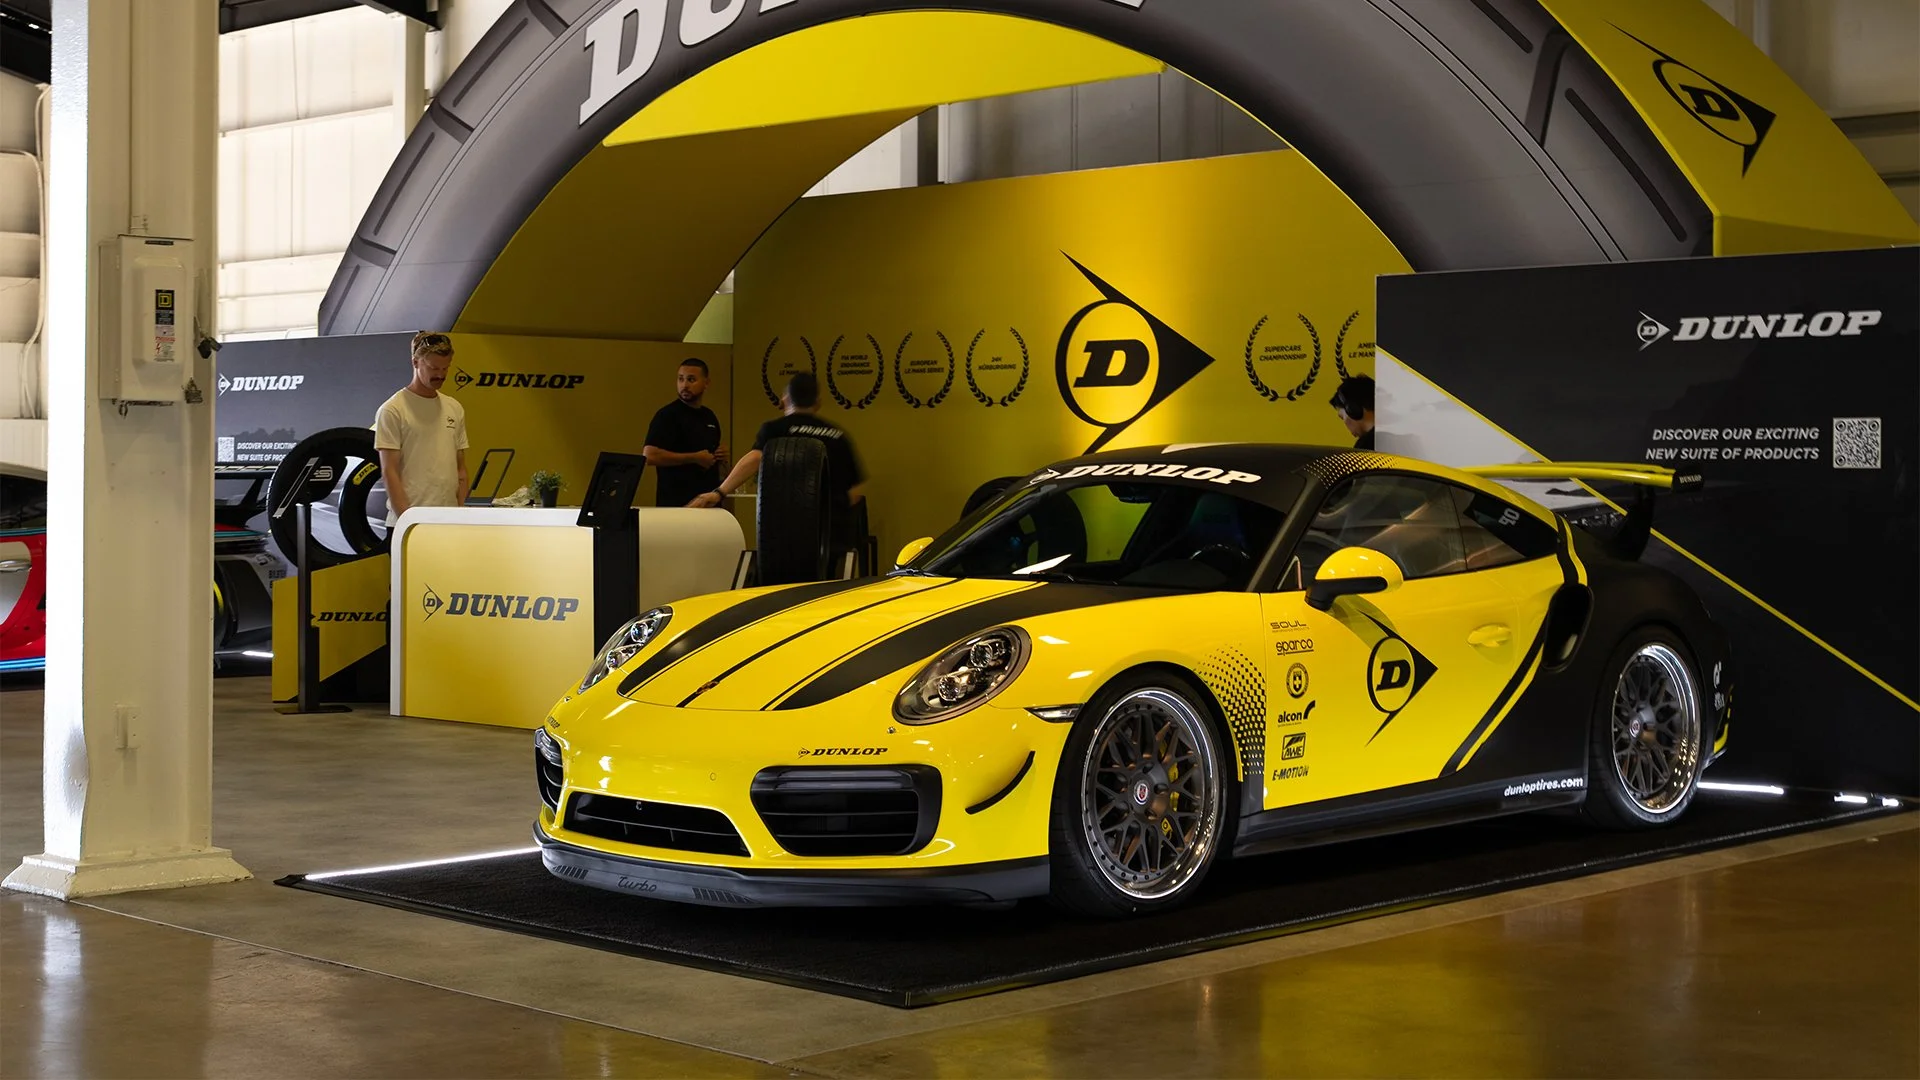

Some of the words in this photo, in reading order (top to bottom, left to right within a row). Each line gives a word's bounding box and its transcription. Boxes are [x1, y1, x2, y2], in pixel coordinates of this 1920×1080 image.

[1678, 83, 1740, 121] D
[1672, 310, 1882, 341] DUNLOP
[1073, 339, 1150, 388] D
[1260, 353, 1307, 361] CHAMPIONSHIP
[231, 375, 304, 391] DUNLOP
[475, 372, 584, 389] DUNLOP
[1653, 428, 1719, 440] DISCOVER
[1722, 428, 1752, 440] OUR
[1755, 427, 1820, 440] EXCITING
[237, 442, 262, 450] DISCOVER
[262, 442, 273, 450] OUR
[1645, 448, 1678, 460] NEW
[1680, 448, 1718, 460] SUITE
[1722, 448, 1742, 460] OF
[1744, 447, 1820, 460] PRODUCTS
[237, 453, 249, 461] NEW
[250, 453, 263, 461] SUITE
[264, 453, 272, 461] OF
[1055, 463, 1262, 485] DUNLOP
[446, 593, 579, 621] DUNLOP
[317, 612, 387, 622] DUNLO
[1270, 620, 1307, 629] SOUL
[1276, 638, 1314, 656] sparco
[1375, 659, 1412, 691] D
[1277, 711, 1303, 723] alcon
[811, 747, 888, 756] DUNLOP
[1284, 745, 1303, 758] AWE
[1272, 765, 1310, 781] E-MOTION
[1503, 777, 1584, 797] dunloptires.com
